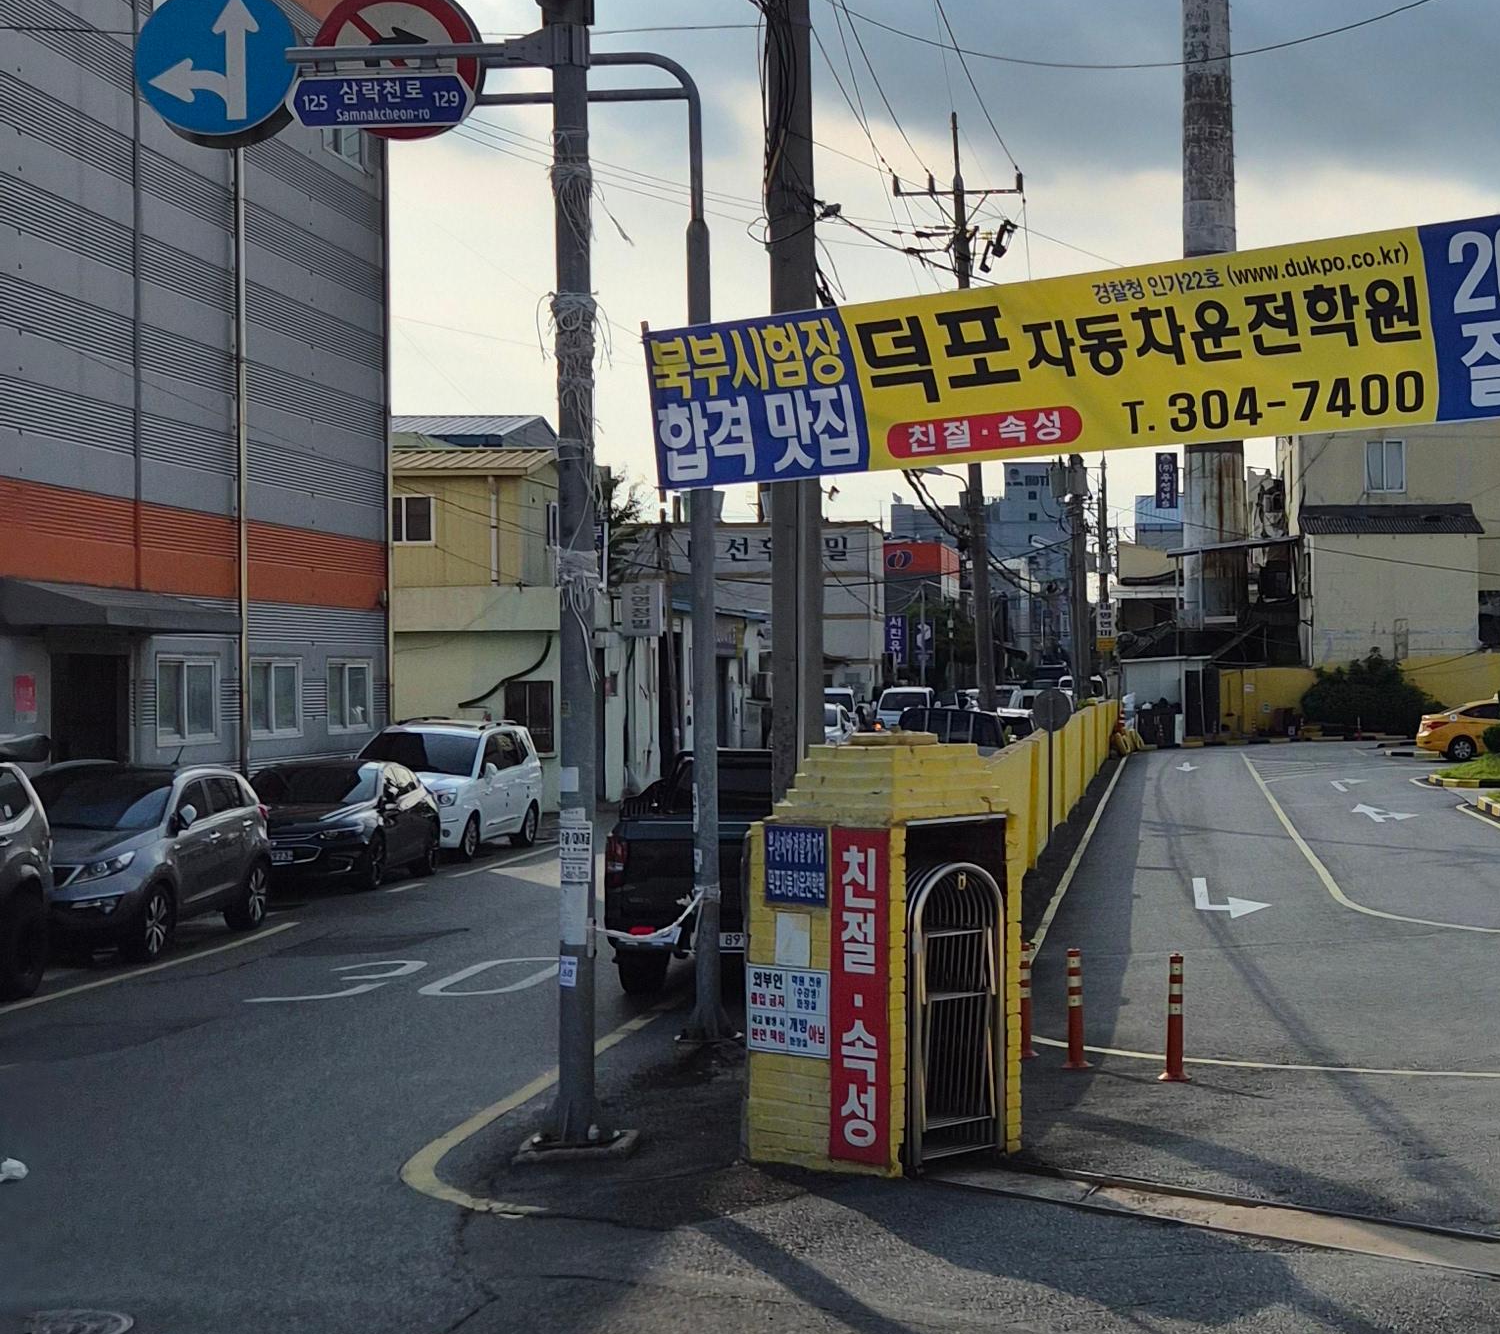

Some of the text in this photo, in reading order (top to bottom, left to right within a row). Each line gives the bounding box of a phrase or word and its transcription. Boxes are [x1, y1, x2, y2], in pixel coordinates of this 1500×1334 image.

[303, 79, 460, 111] 125 삼락천로 129
[336, 107, 430, 122] Samnakcheon-ro
[1091, 240, 1409, 305] 경찰청 인가22호 (www.dukpo.co.kr)
[855, 275, 1422, 403] 덕포 자동차운전학원
[651, 318, 845, 400] 북부시험장
[657, 382, 856, 481] 합격 맛집
[753, 971, 783, 990] 외부인
[769, 994, 785, 1008] 금지
[789, 1017, 826, 1045] 개방 아님
